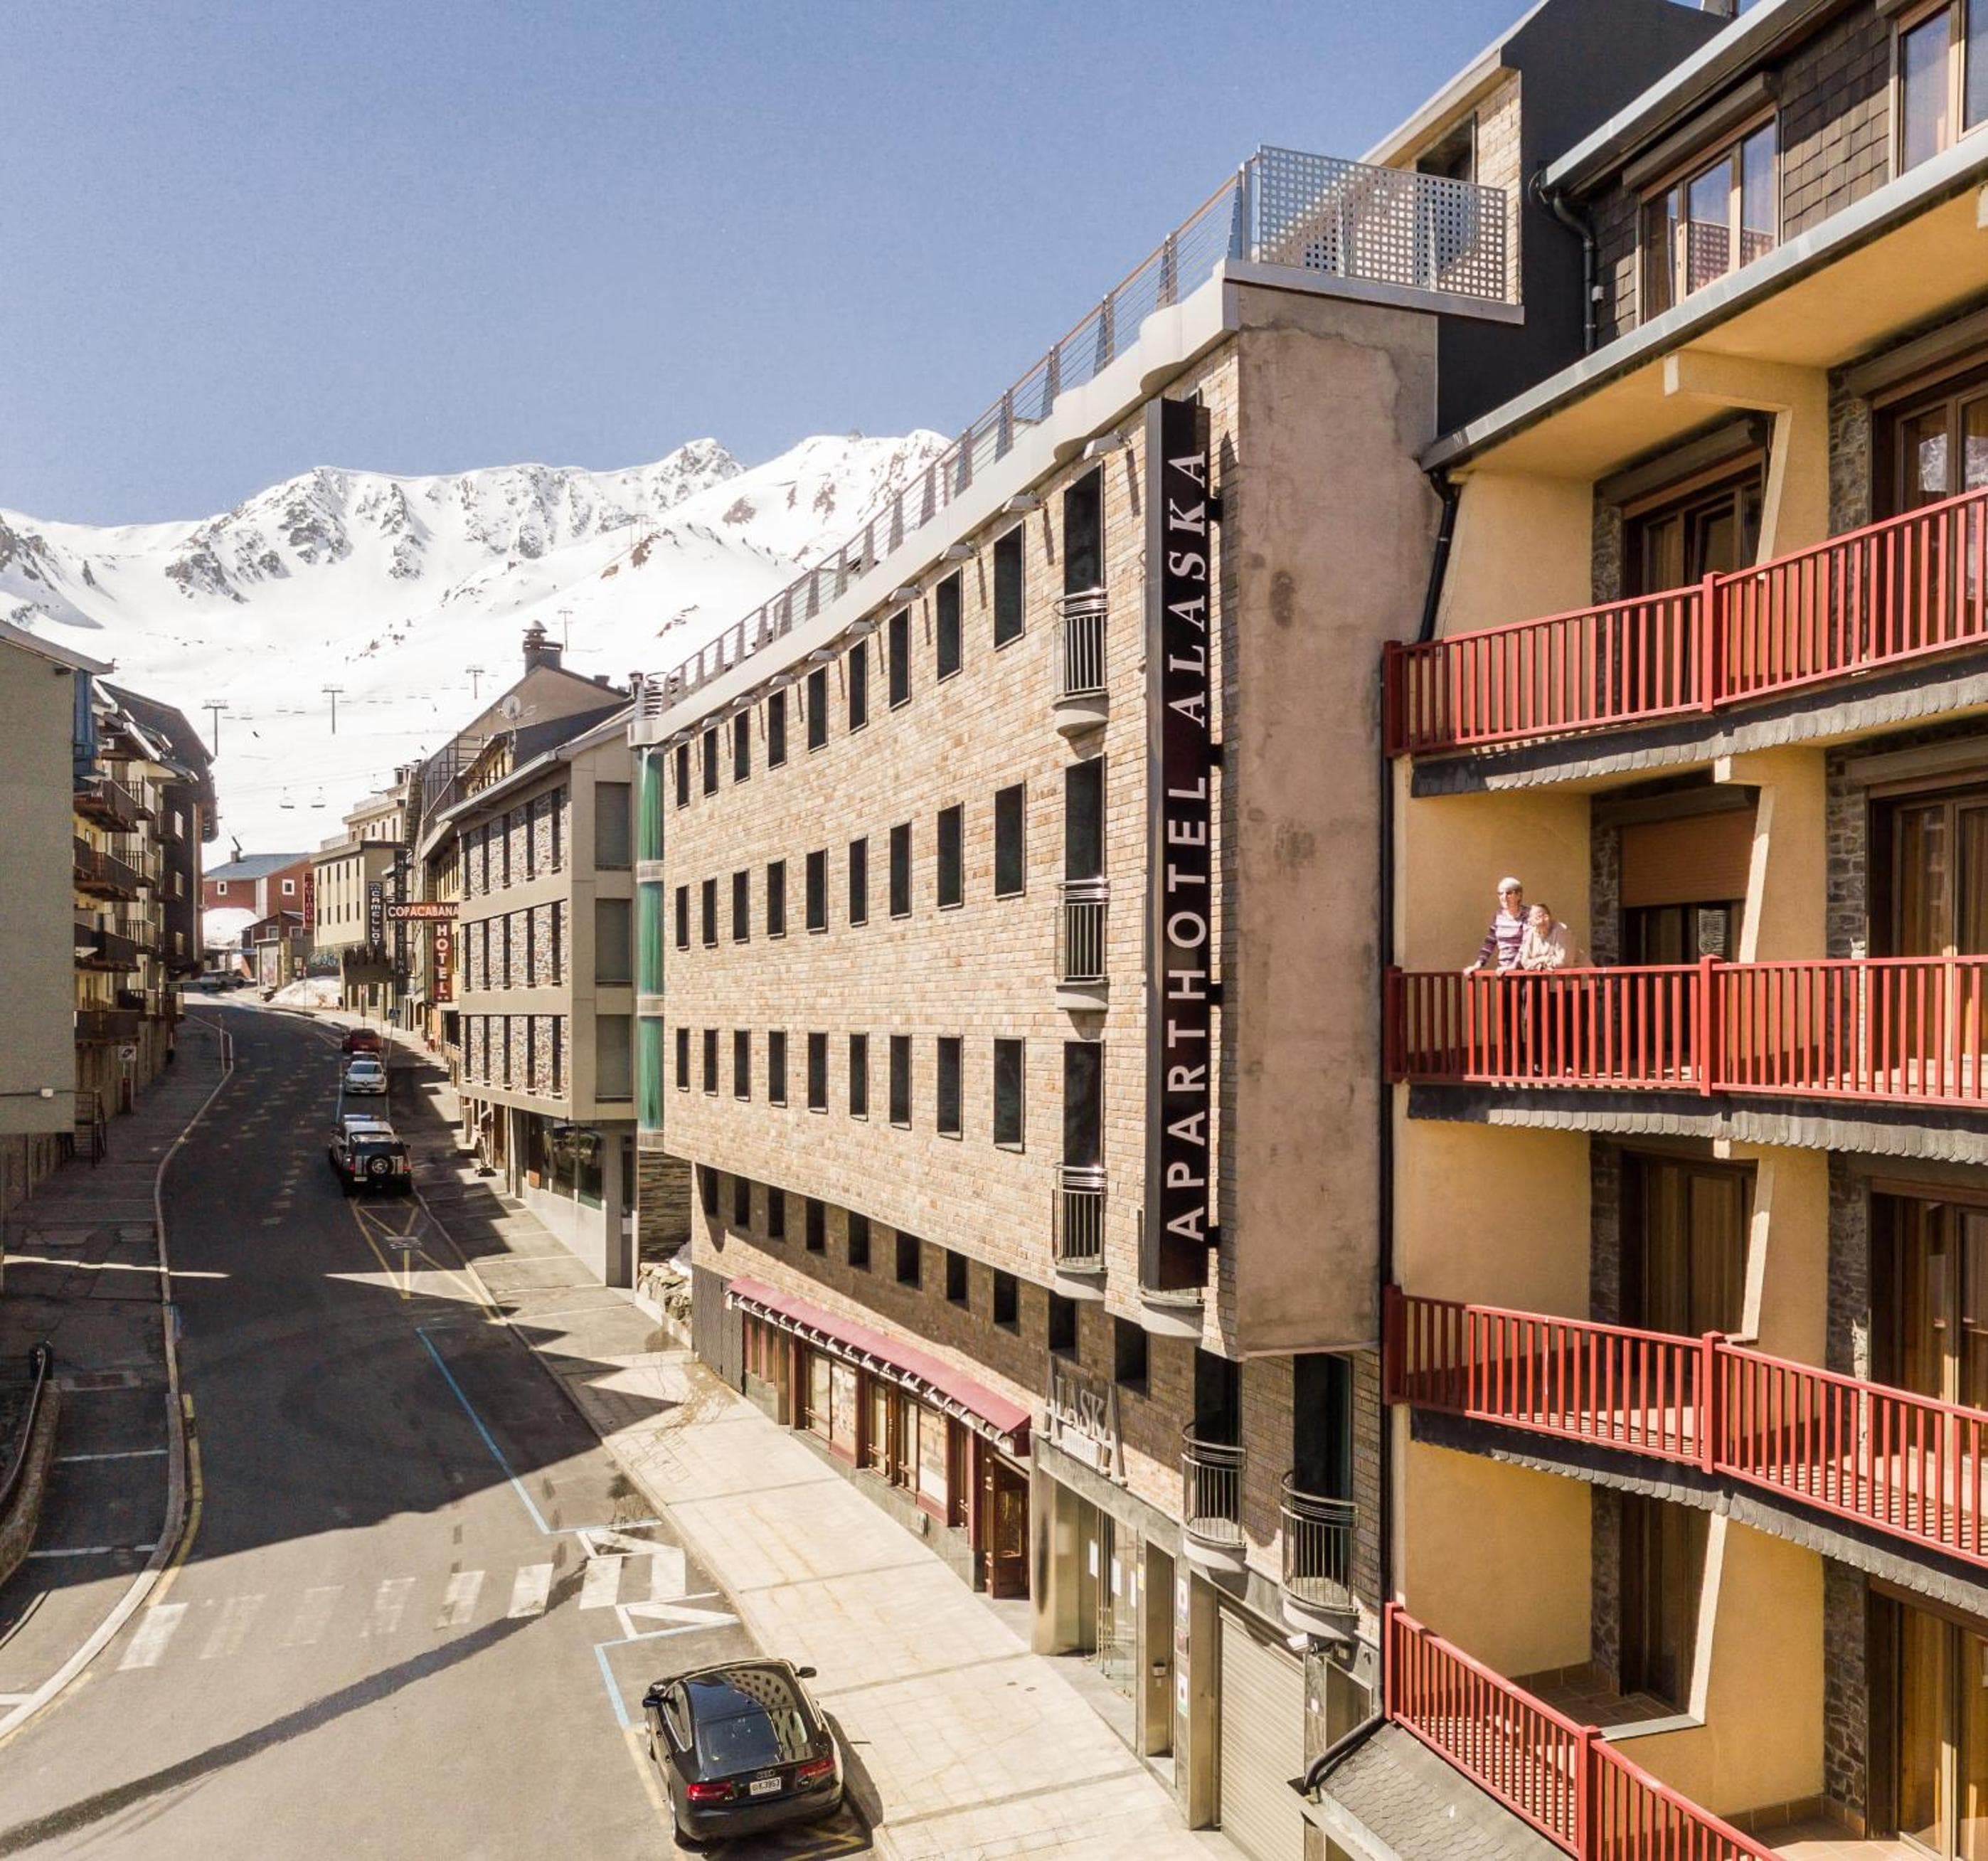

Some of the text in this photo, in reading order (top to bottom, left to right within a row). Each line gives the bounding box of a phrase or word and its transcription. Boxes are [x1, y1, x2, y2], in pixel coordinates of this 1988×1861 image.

[1166, 451, 1207, 1242] APARTHOTEL ALASKA
[388, 906, 458, 918] COPACABANA
[436, 925, 449, 994] HOTEL
[1044, 1351, 1128, 1487] ALASKA
